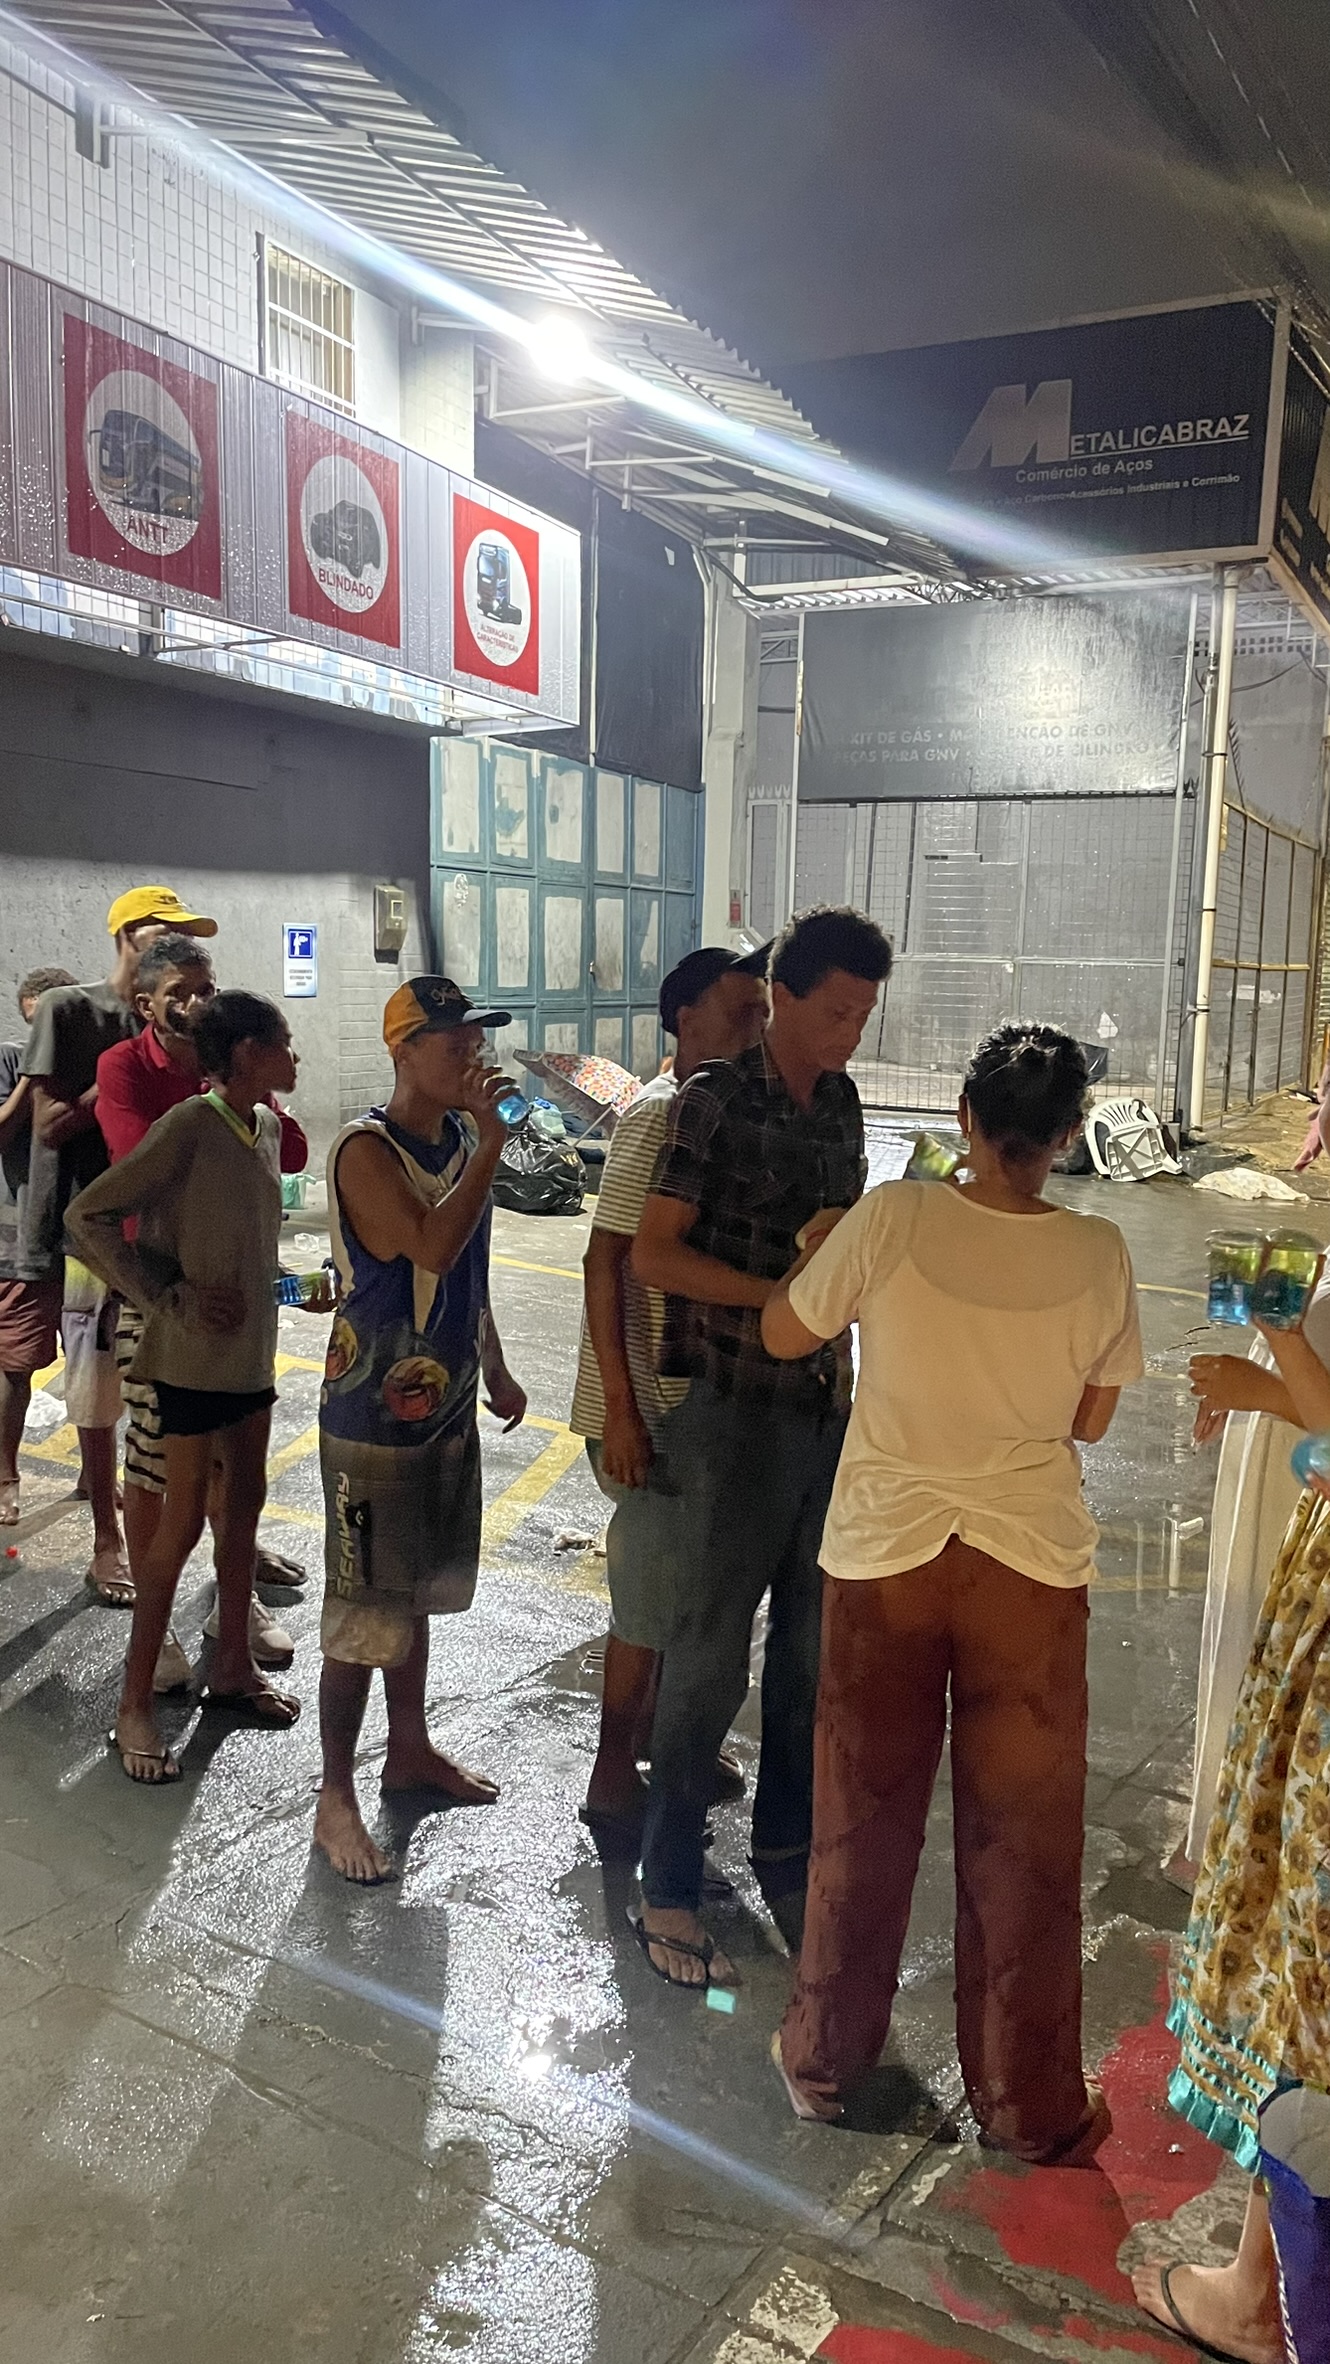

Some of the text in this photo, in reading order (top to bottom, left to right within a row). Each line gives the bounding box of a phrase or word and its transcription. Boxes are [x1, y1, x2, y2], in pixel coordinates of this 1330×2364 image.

[1015, 458, 1154, 483] Comércio de Aços
[1127, 479, 1180, 493] Industriais
[127, 515, 168, 544] ANTT
[318, 567, 374, 600] BLINDADO
[850, 731, 873, 745] KIT
[877, 730, 897, 744] DE
[900, 726, 931, 744] GÁS
[881, 749, 919, 763] PARA
[924, 747, 960, 761] GNV
